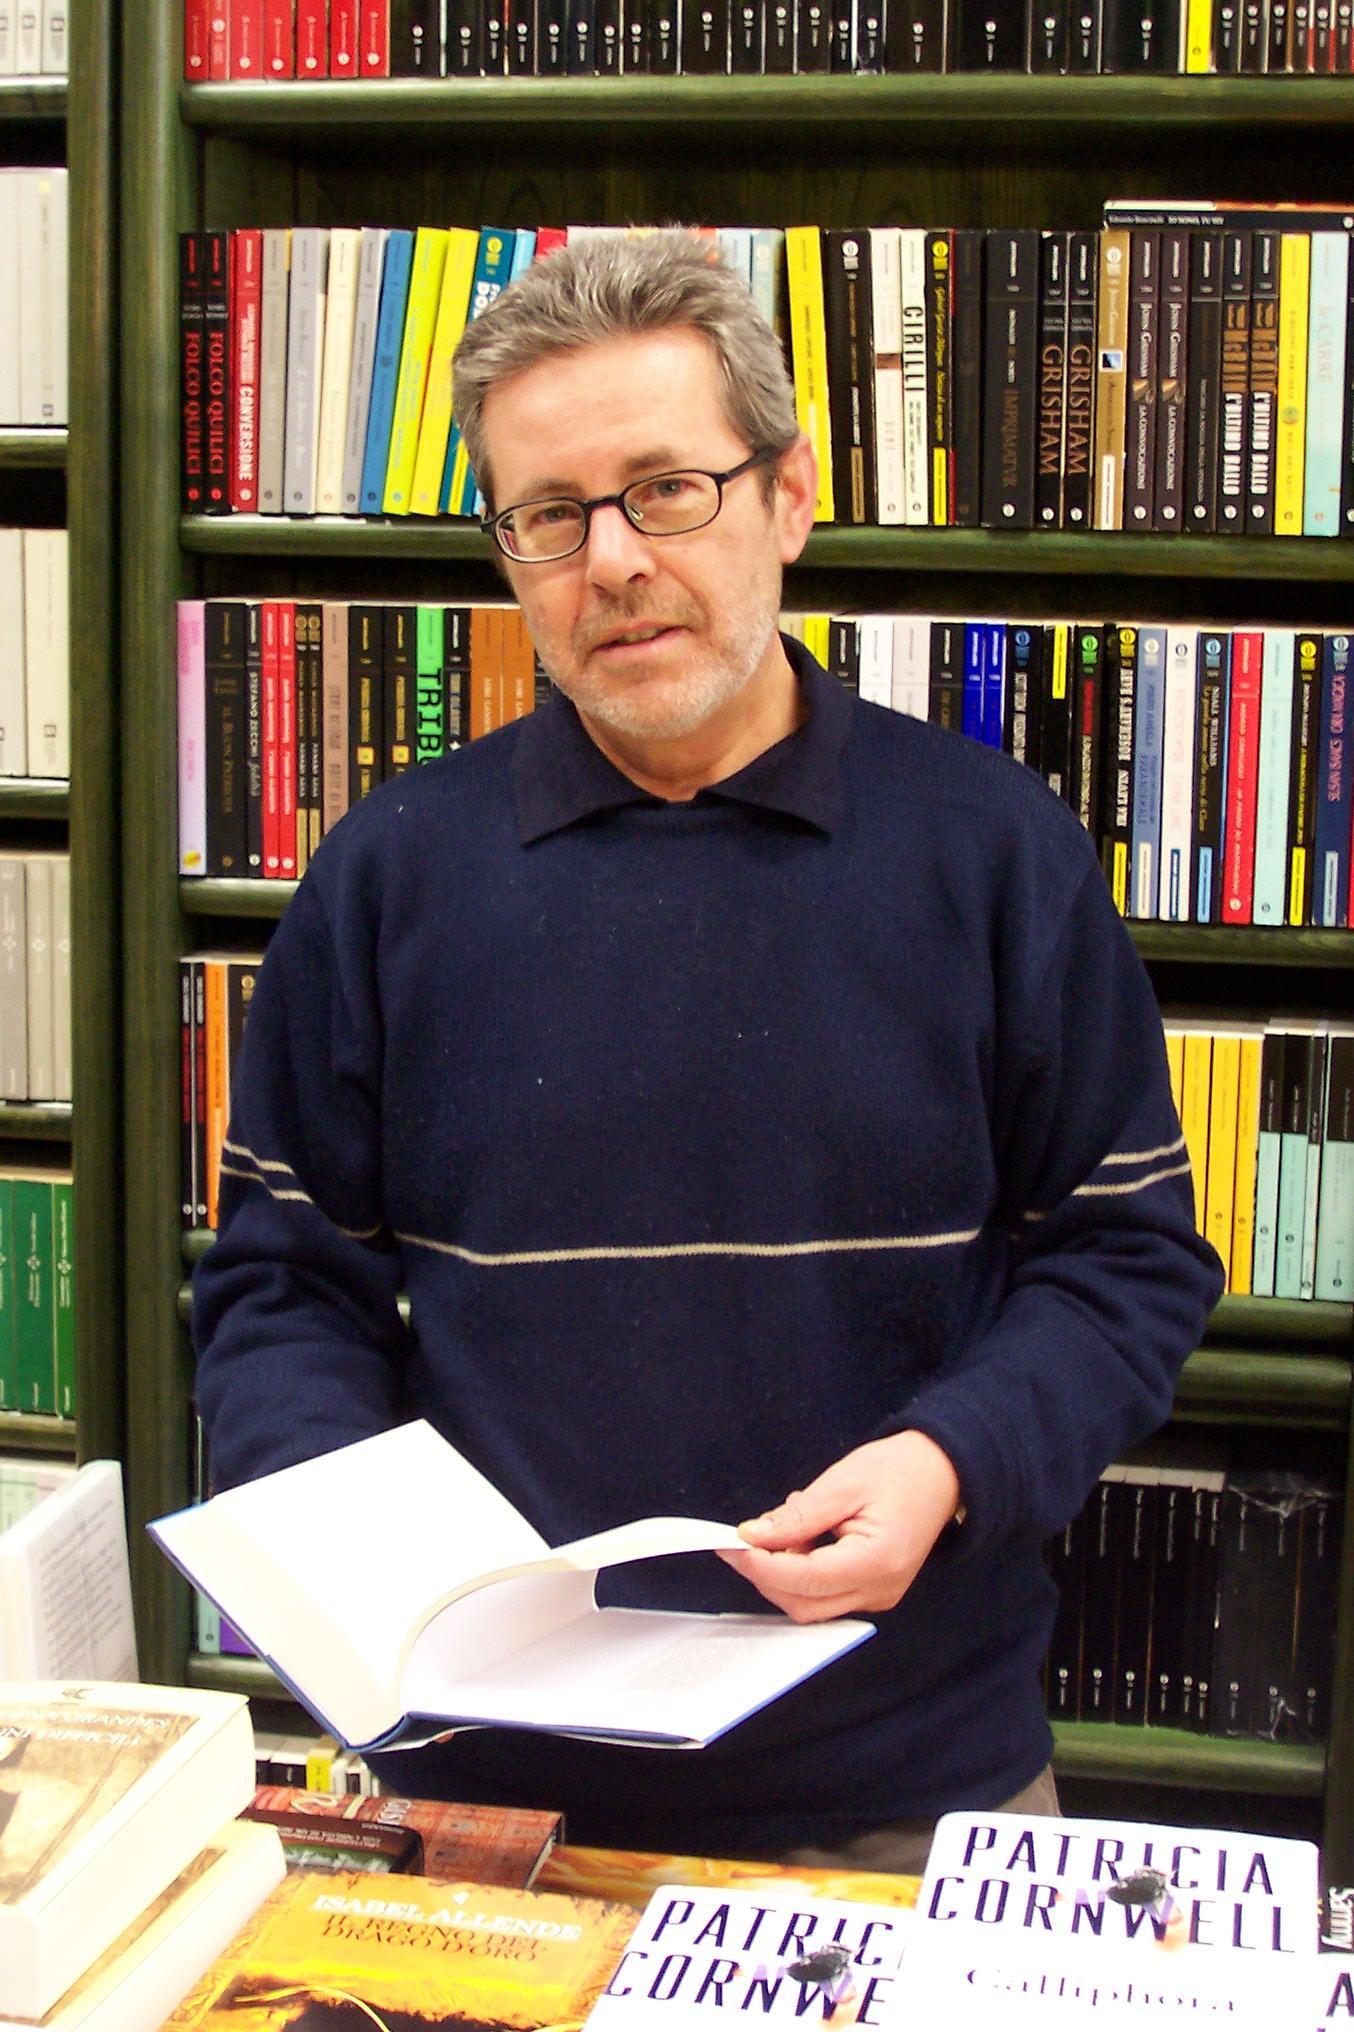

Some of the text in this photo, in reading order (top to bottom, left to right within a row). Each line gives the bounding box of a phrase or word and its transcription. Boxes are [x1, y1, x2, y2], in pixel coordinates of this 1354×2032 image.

[904, 306, 925, 392] CIRILLI
[184, 332, 201, 475] FOLCO QUILICI
[207, 332, 225, 475] FOLCO QUILICI
[239, 386, 254, 481] CONVERSIONE
[1040, 344, 1063, 475] GRISHAM
[1067, 344, 1091, 476] GRISHAM
[1222, 454, 1241, 496] BALLO
[1250, 453, 1269, 495] BALLO
[249, 671, 259, 718] STEFANO
[1209, 686, 1221, 768] NIALL WILLIAMS
[250, 718, 259, 758] ZECCHI
[1116, 768, 1130, 806] LEVIN
[962, 1826, 1274, 1895] PATRICIA
[310, 1894, 584, 1943] ISABEL ALLENDE
[321, 1924, 537, 1962] DRAGO D'ORO
[326, 1913, 547, 1952] IL REGNO DEL
[651, 1900, 905, 1967] PATRIC
[927, 1876, 1295, 1954] CORNWELL
